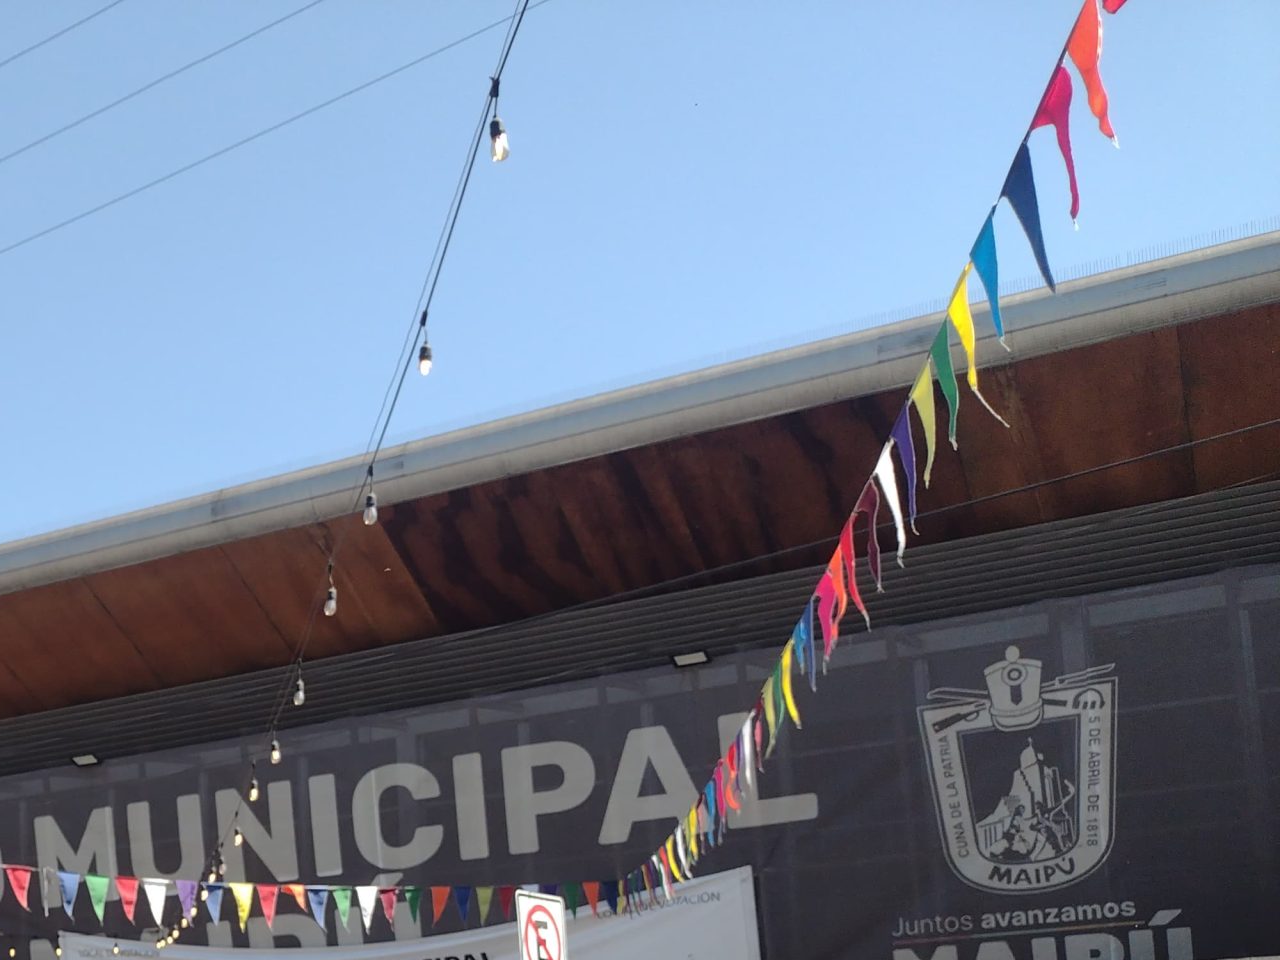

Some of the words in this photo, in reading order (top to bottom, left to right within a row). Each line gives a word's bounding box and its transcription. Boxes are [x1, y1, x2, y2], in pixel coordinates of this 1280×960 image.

[1088, 727, 1101, 747] DE
[937, 735, 956, 778] PATRIA
[1087, 751, 1101, 790] ABRIL
[945, 780, 960, 799] LA
[1086, 794, 1100, 813] DE
[32, 711, 819, 908] MUNICIPAL
[948, 800, 962, 819] DE
[952, 822, 969, 859] CUNA
[1085, 818, 1099, 847] 1818
[892, 916, 974, 938] Juntos
[980, 900, 1137, 929] avanzamos
